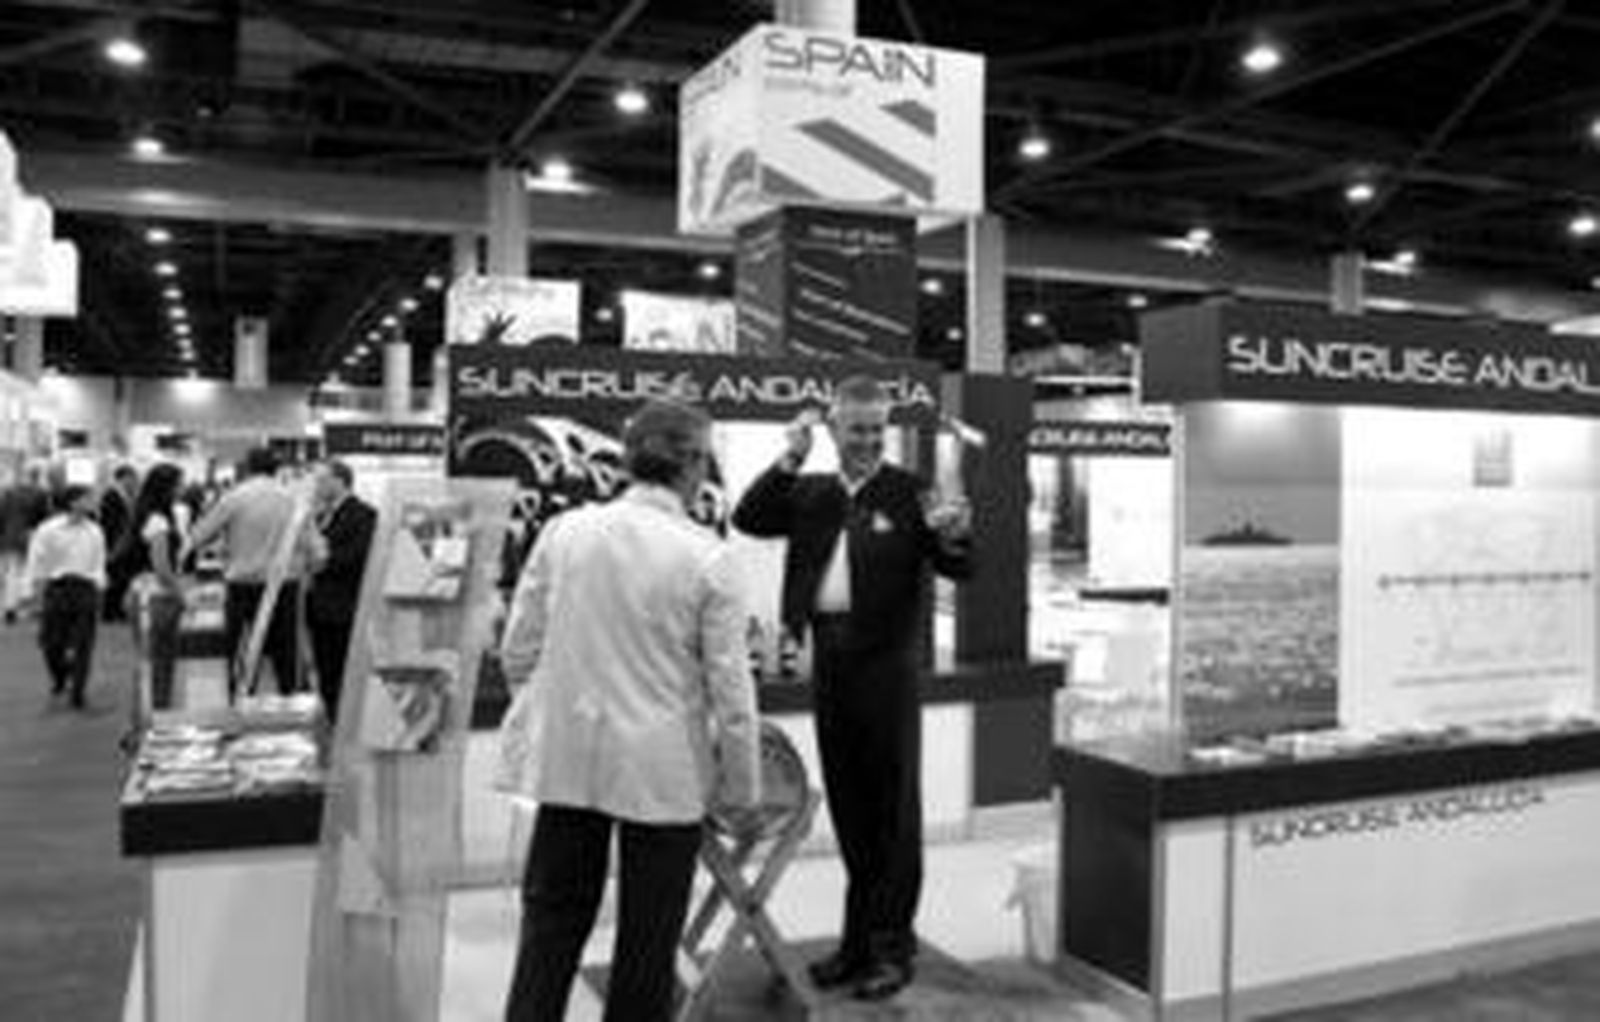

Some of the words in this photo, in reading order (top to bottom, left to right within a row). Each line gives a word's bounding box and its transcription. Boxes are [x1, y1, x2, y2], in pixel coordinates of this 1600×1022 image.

[764, 32, 936, 89] SPAIN
[456, 365, 701, 399] SUNCRUISE
[1227, 336, 1470, 386] SUNCRUISE
